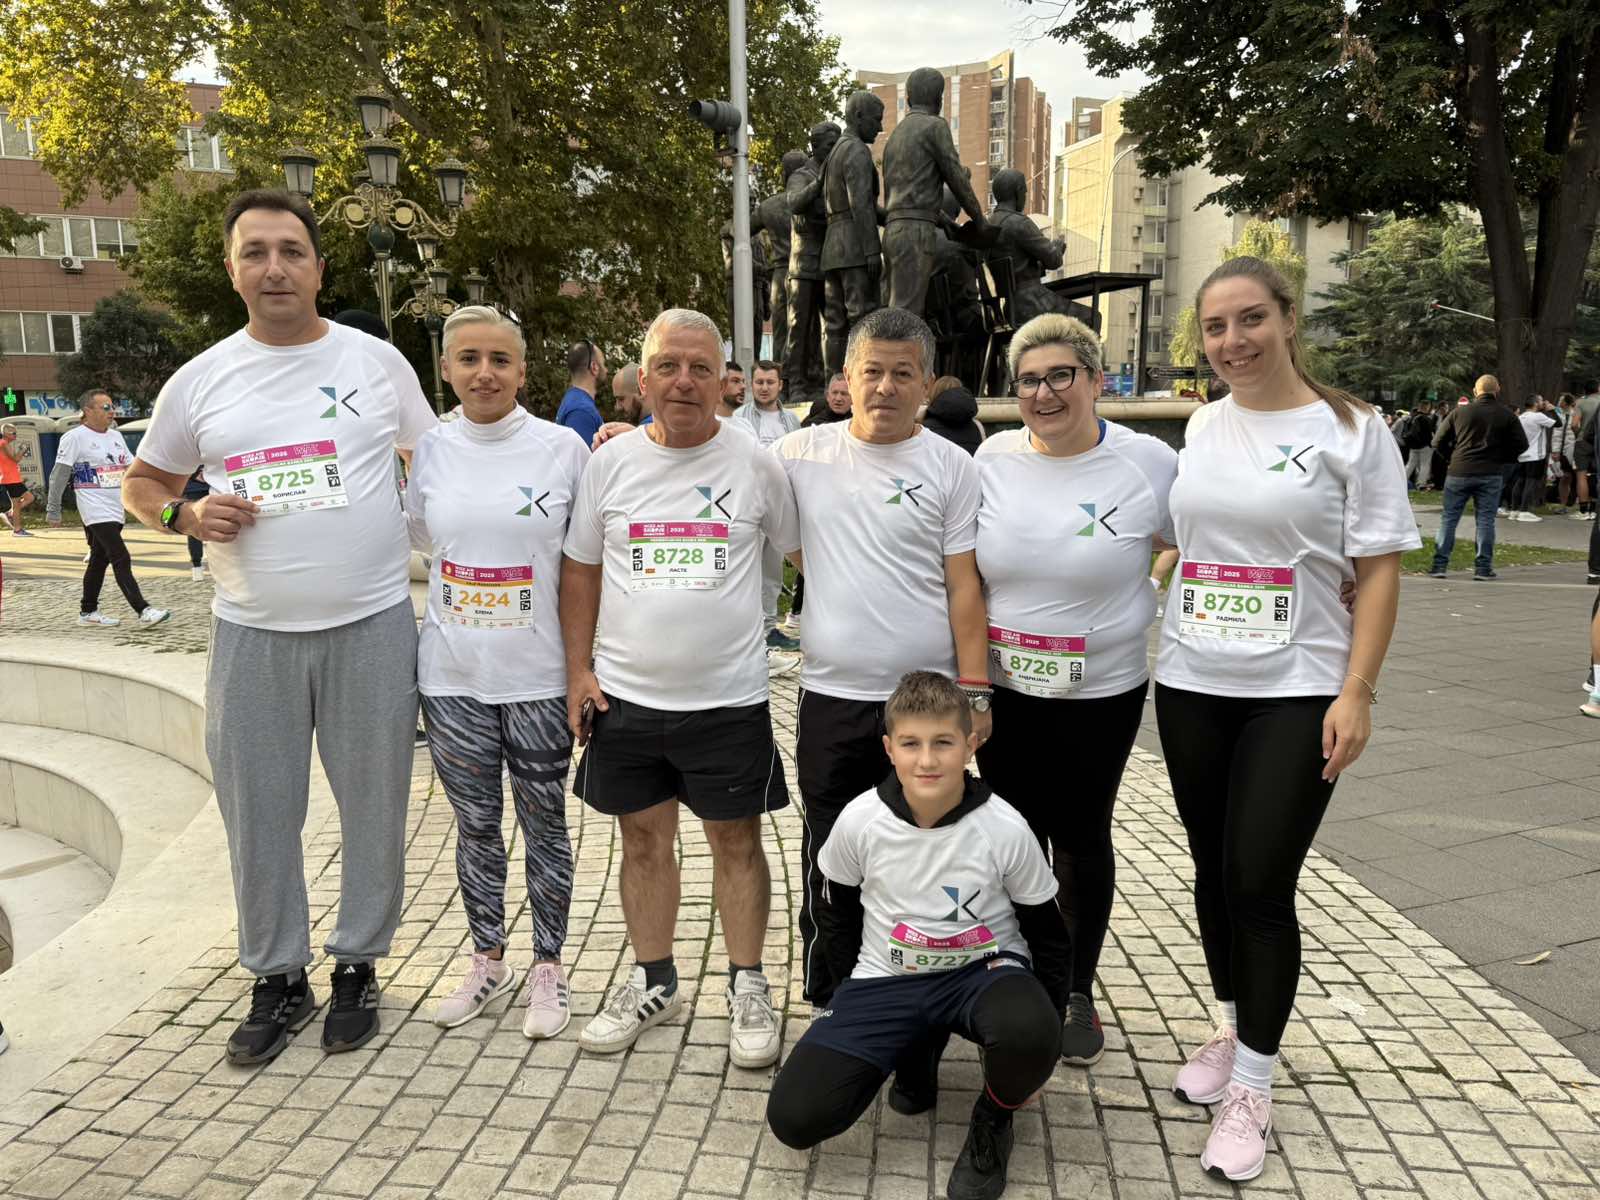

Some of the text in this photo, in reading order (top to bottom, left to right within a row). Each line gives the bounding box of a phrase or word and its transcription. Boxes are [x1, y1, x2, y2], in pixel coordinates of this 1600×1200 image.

[258, 469, 315, 491] 8725
[653, 548, 704, 564] 8728
[1223, 570, 1240, 578] 2025
[459, 590, 510, 608] 2424
[1204, 593, 1262, 614] 8730
[1216, 615, 1247, 623] РАДМИЛА
[1010, 656, 1058, 676] 8726
[916, 955, 971, 966] 8727
